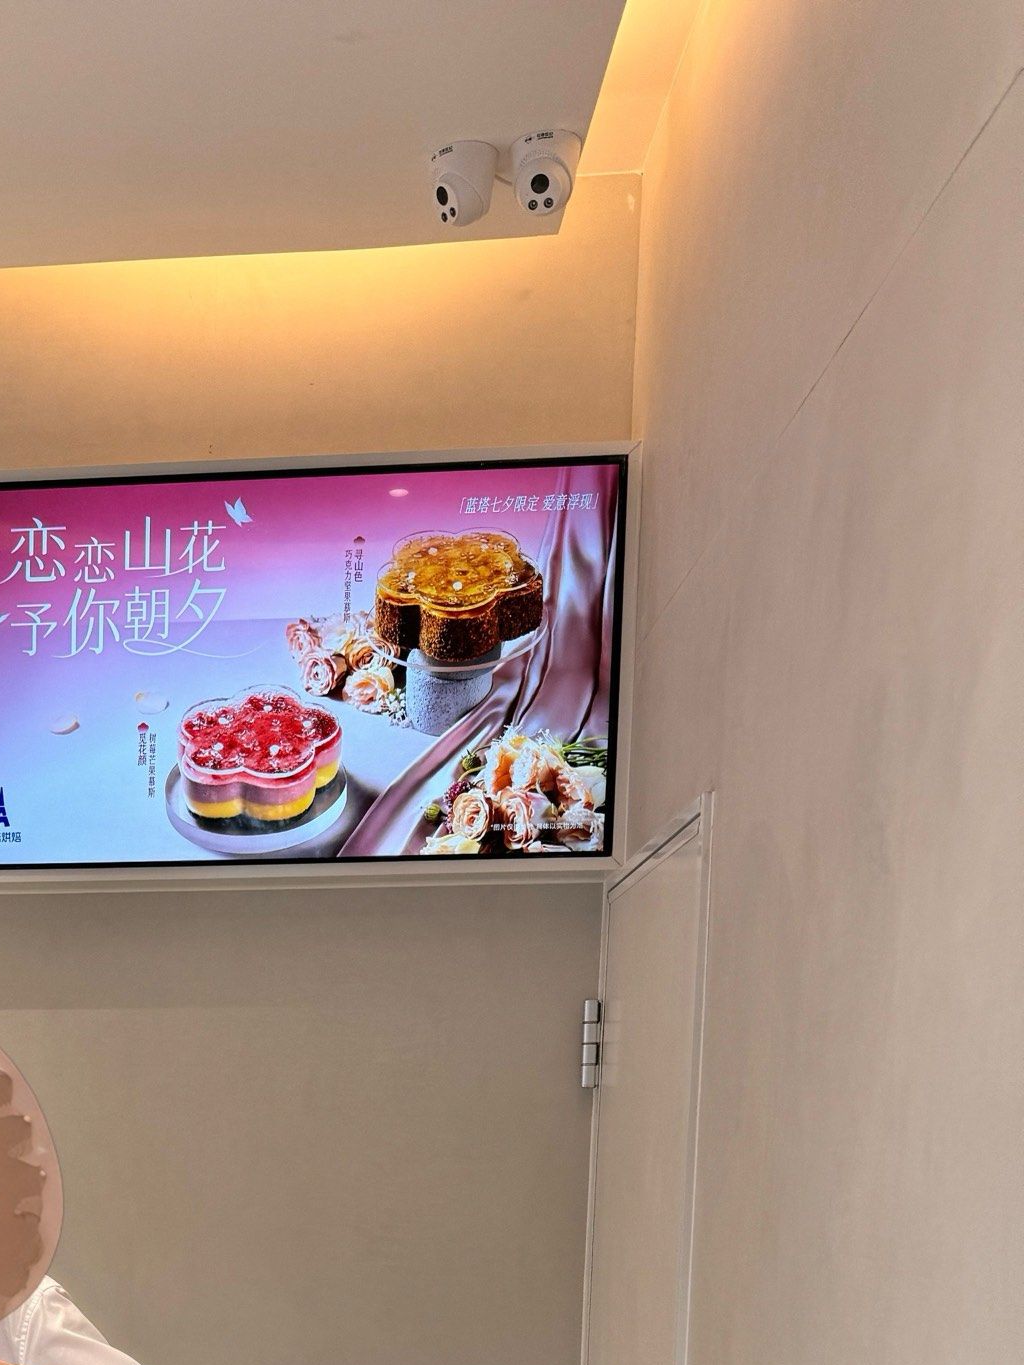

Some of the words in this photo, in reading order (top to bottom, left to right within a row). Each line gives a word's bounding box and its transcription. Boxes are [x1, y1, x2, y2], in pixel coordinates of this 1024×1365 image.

[354, 549, 364, 582] 寻山色
[11, 578, 230, 659] 予你朝夕
